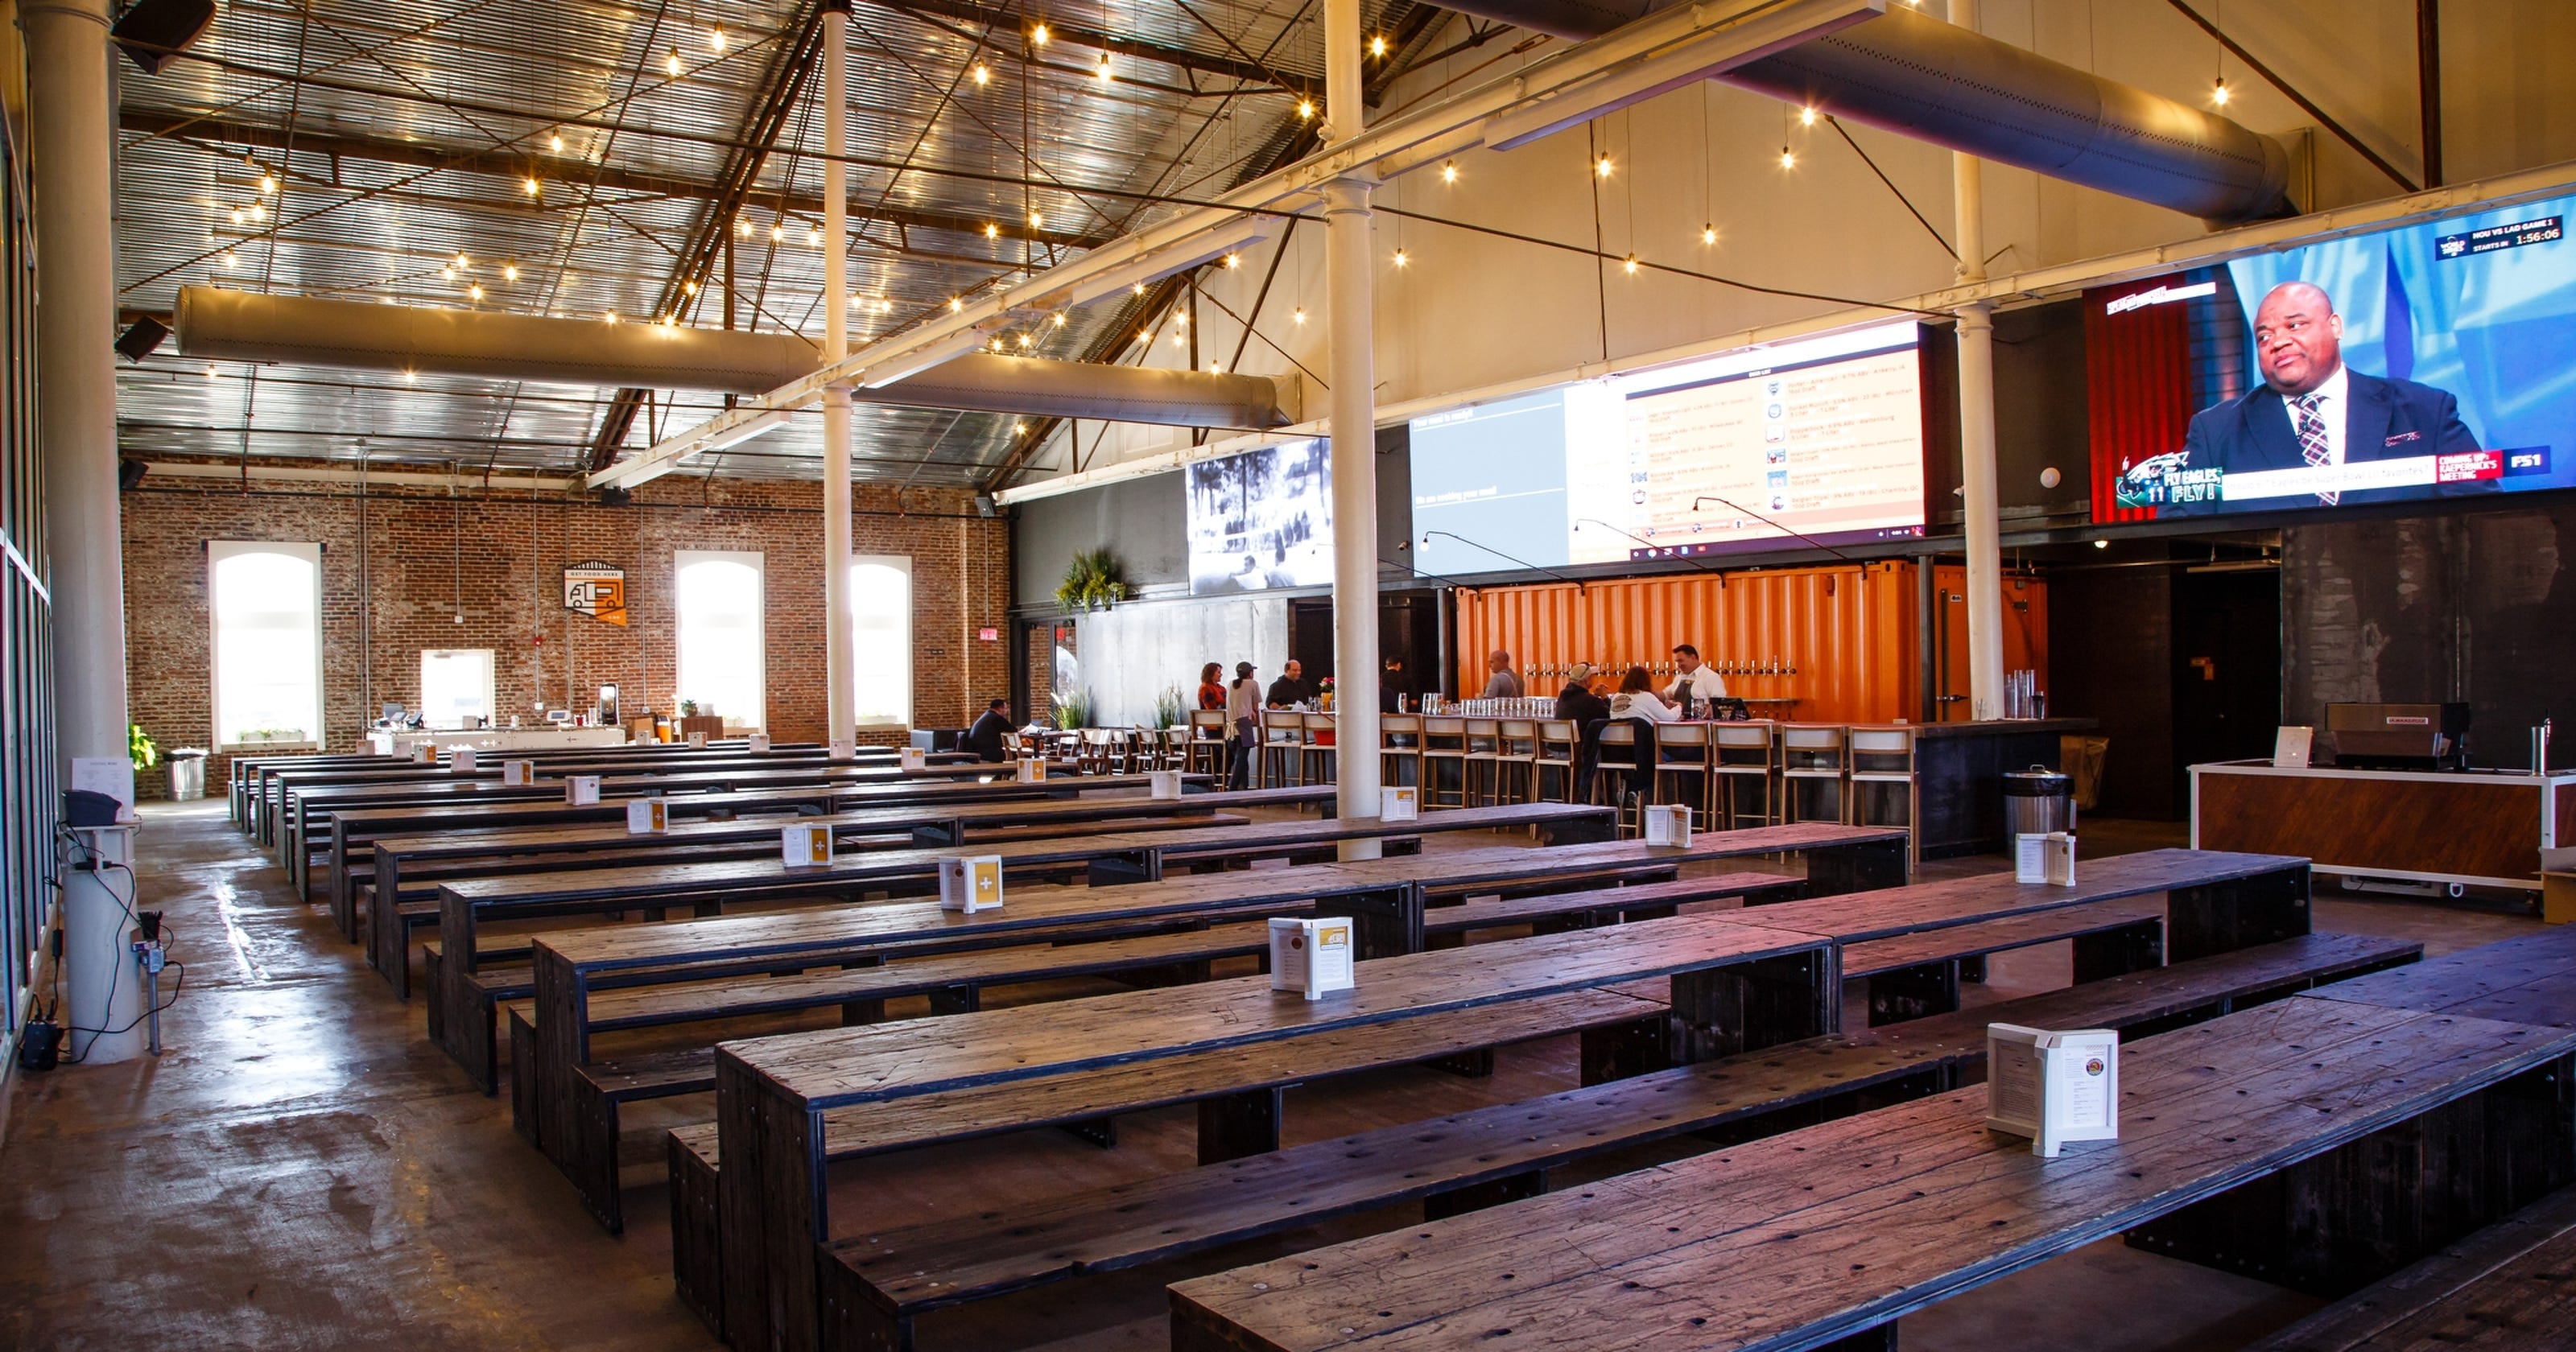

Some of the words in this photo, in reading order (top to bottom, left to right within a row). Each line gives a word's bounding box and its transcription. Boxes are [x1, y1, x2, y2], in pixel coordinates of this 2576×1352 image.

[2473, 230, 2491, 240] HOU
[2492, 228, 2504, 236] VS
[2504, 225, 2520, 234] LAD
[2522, 220, 2547, 230] GAME
[2516, 229, 2560, 245] 1:56:06
[2473, 241, 2500, 253] STARTS
[2500, 240, 2509, 248] IN
[2439, 455, 2473, 465] COMING
[2439, 460, 2497, 473] KAEPERNICK'S
[2511, 454, 2541, 468] FS1
[2439, 470, 2477, 482] MEETING
[2148, 486, 2165, 502] 11
